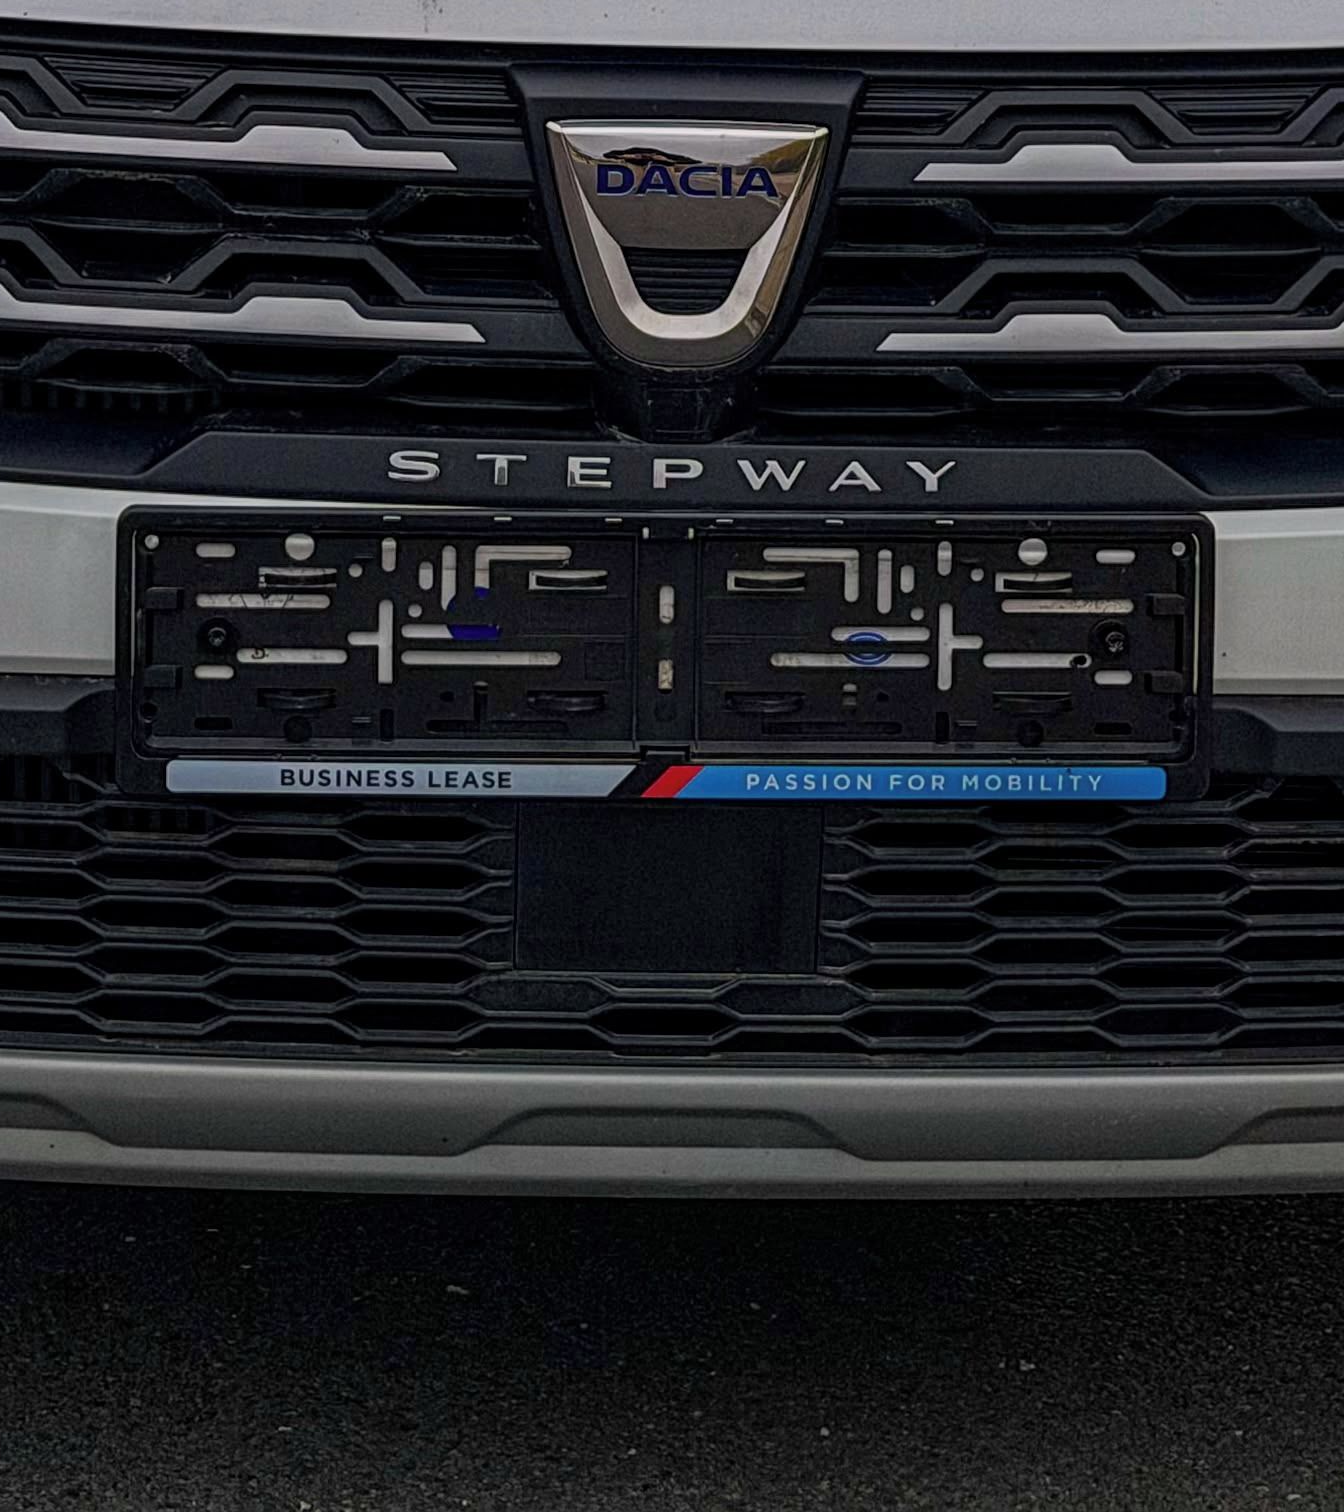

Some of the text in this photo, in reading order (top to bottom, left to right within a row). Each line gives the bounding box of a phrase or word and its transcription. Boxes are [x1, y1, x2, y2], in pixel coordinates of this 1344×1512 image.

[596, 163, 779, 197] DACIA
[387, 450, 956, 492] STEPWAY
[280, 768, 512, 789] BUSINESS LEASE
[746, 773, 1102, 792] PASSION FOR MOBILITY
